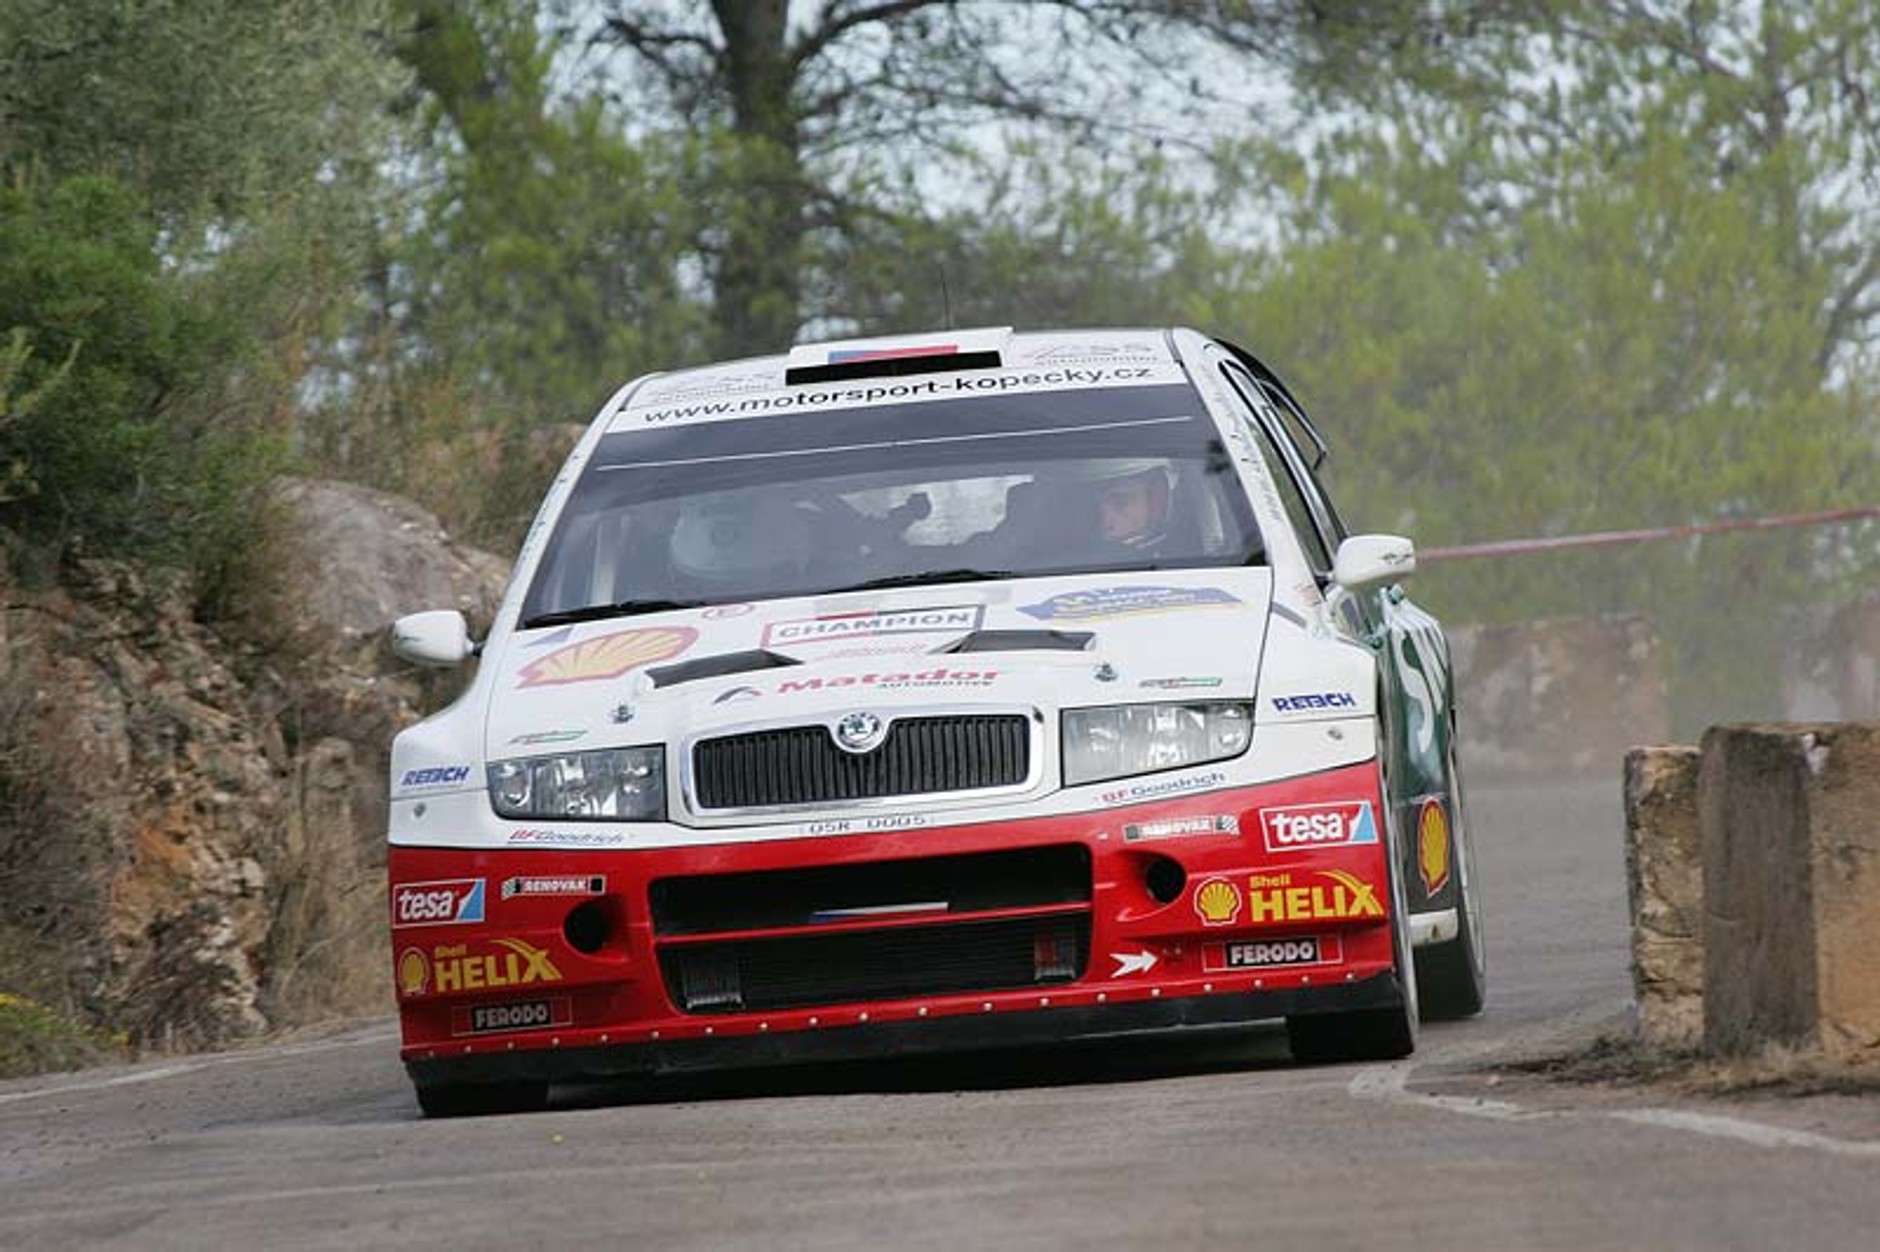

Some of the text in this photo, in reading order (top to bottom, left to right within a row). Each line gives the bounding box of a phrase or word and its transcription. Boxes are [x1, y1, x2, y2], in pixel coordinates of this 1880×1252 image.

[645, 367, 1154, 423] www.motorsport-kopecky.cz
[779, 613, 969, 638] CHAMPION
[778, 669, 1000, 694] Matador
[1269, 811, 1344, 843] tesa
[1249, 869, 1384, 922] HELIX
[1250, 873, 1291, 889] Shell
[398, 887, 453, 921] tesa
[434, 938, 563, 993] HELIX
[1231, 944, 1315, 965] FERODO
[475, 1003, 549, 1029] FERODO
